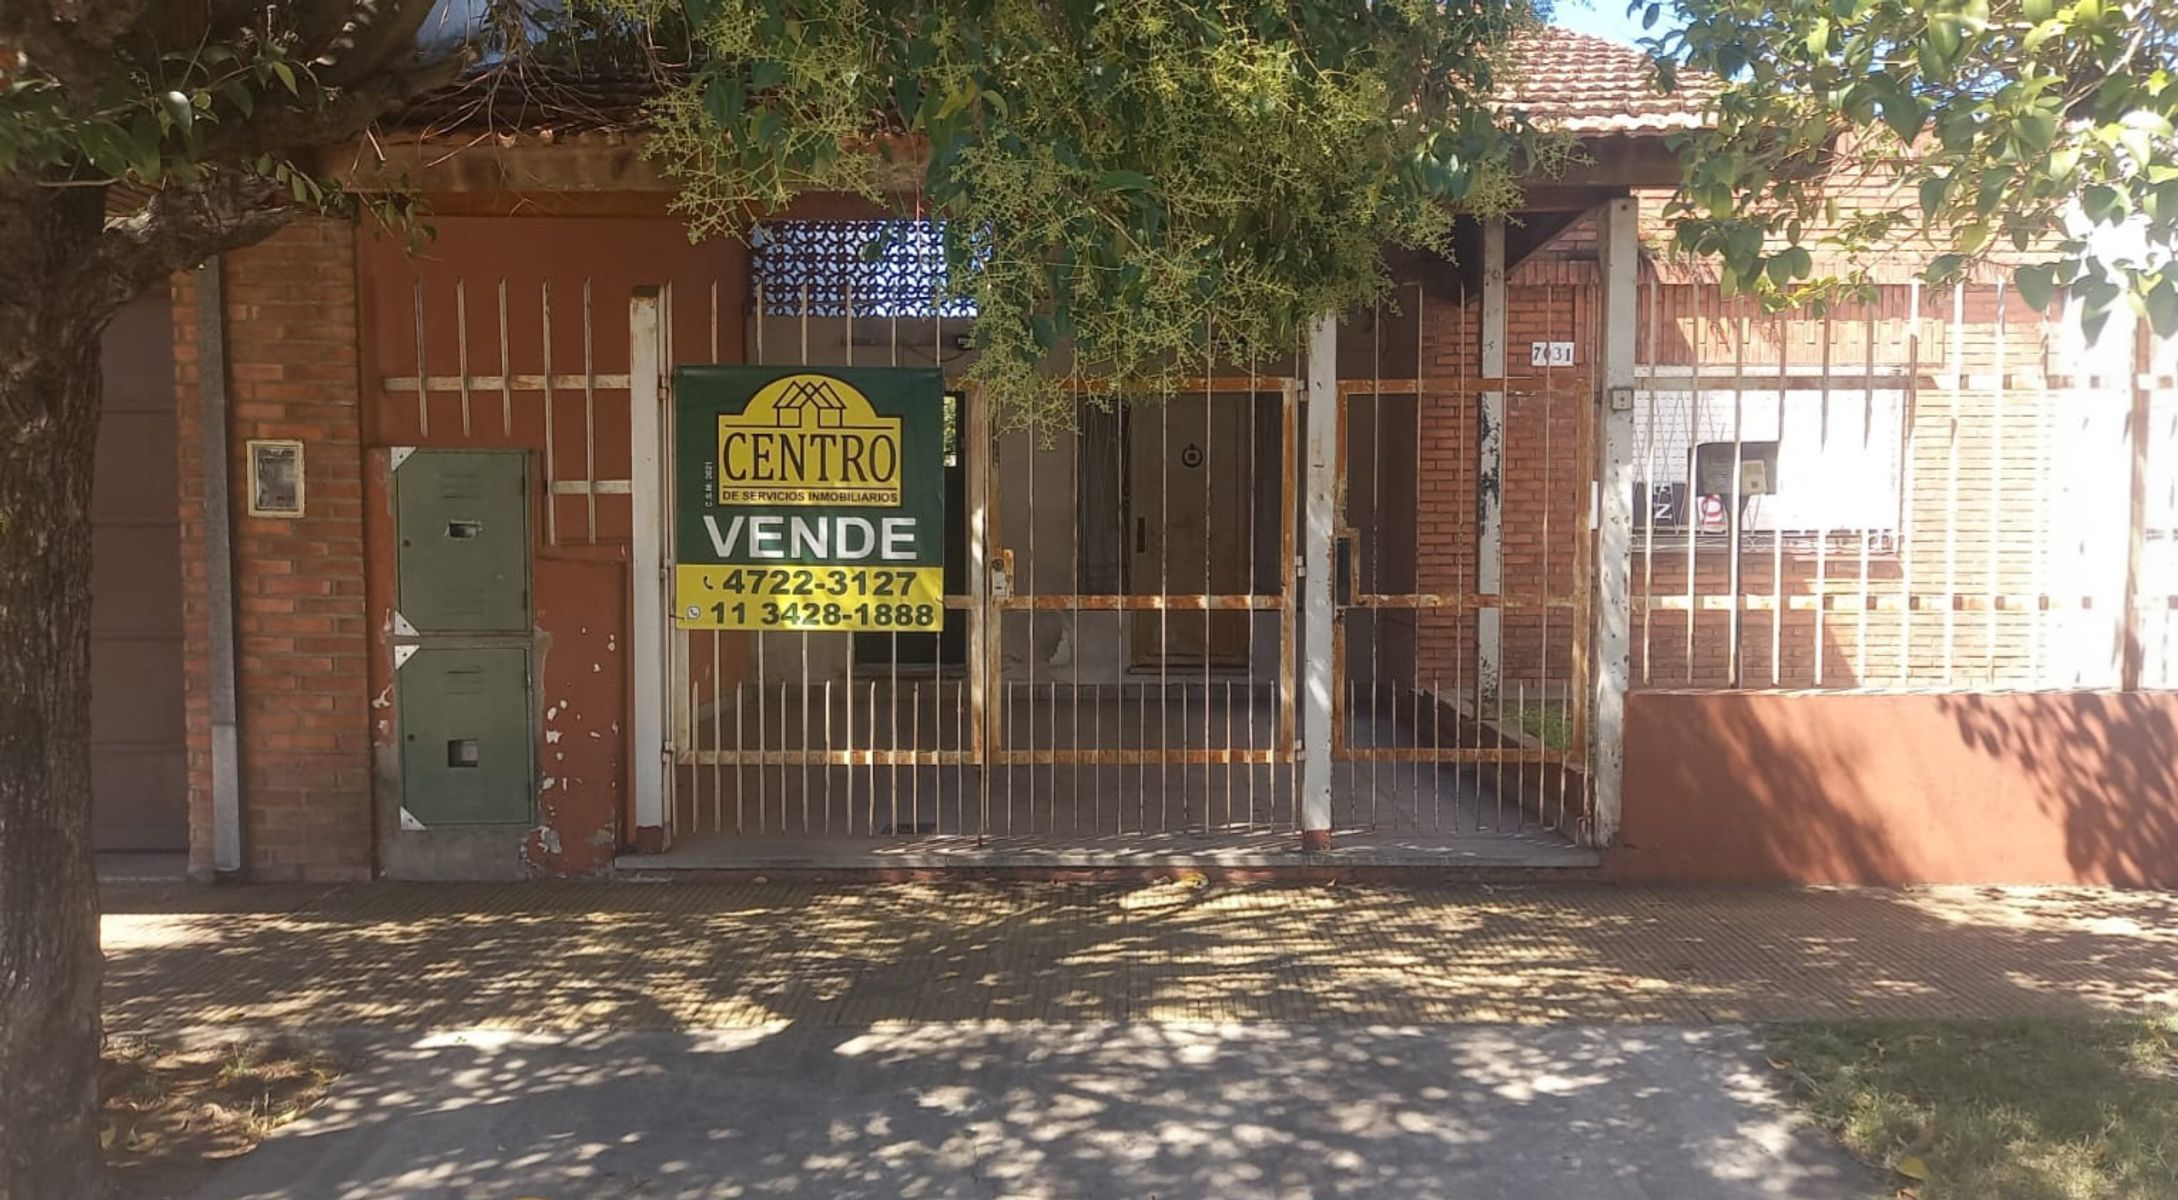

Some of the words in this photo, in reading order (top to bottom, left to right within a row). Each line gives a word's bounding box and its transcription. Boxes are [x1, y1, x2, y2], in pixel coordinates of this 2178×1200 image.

[722, 432, 897, 483] CENTRO
[722, 490, 739, 501] DE
[742, 490, 805, 502] SERVICIOS
[808, 491, 898, 503] INMOBILIARIOS
[702, 514, 918, 560] VENDE
[722, 568, 918, 597] 4722-3127
[711, 602, 746, 625] 11
[761, 602, 935, 627] 3428-1888
